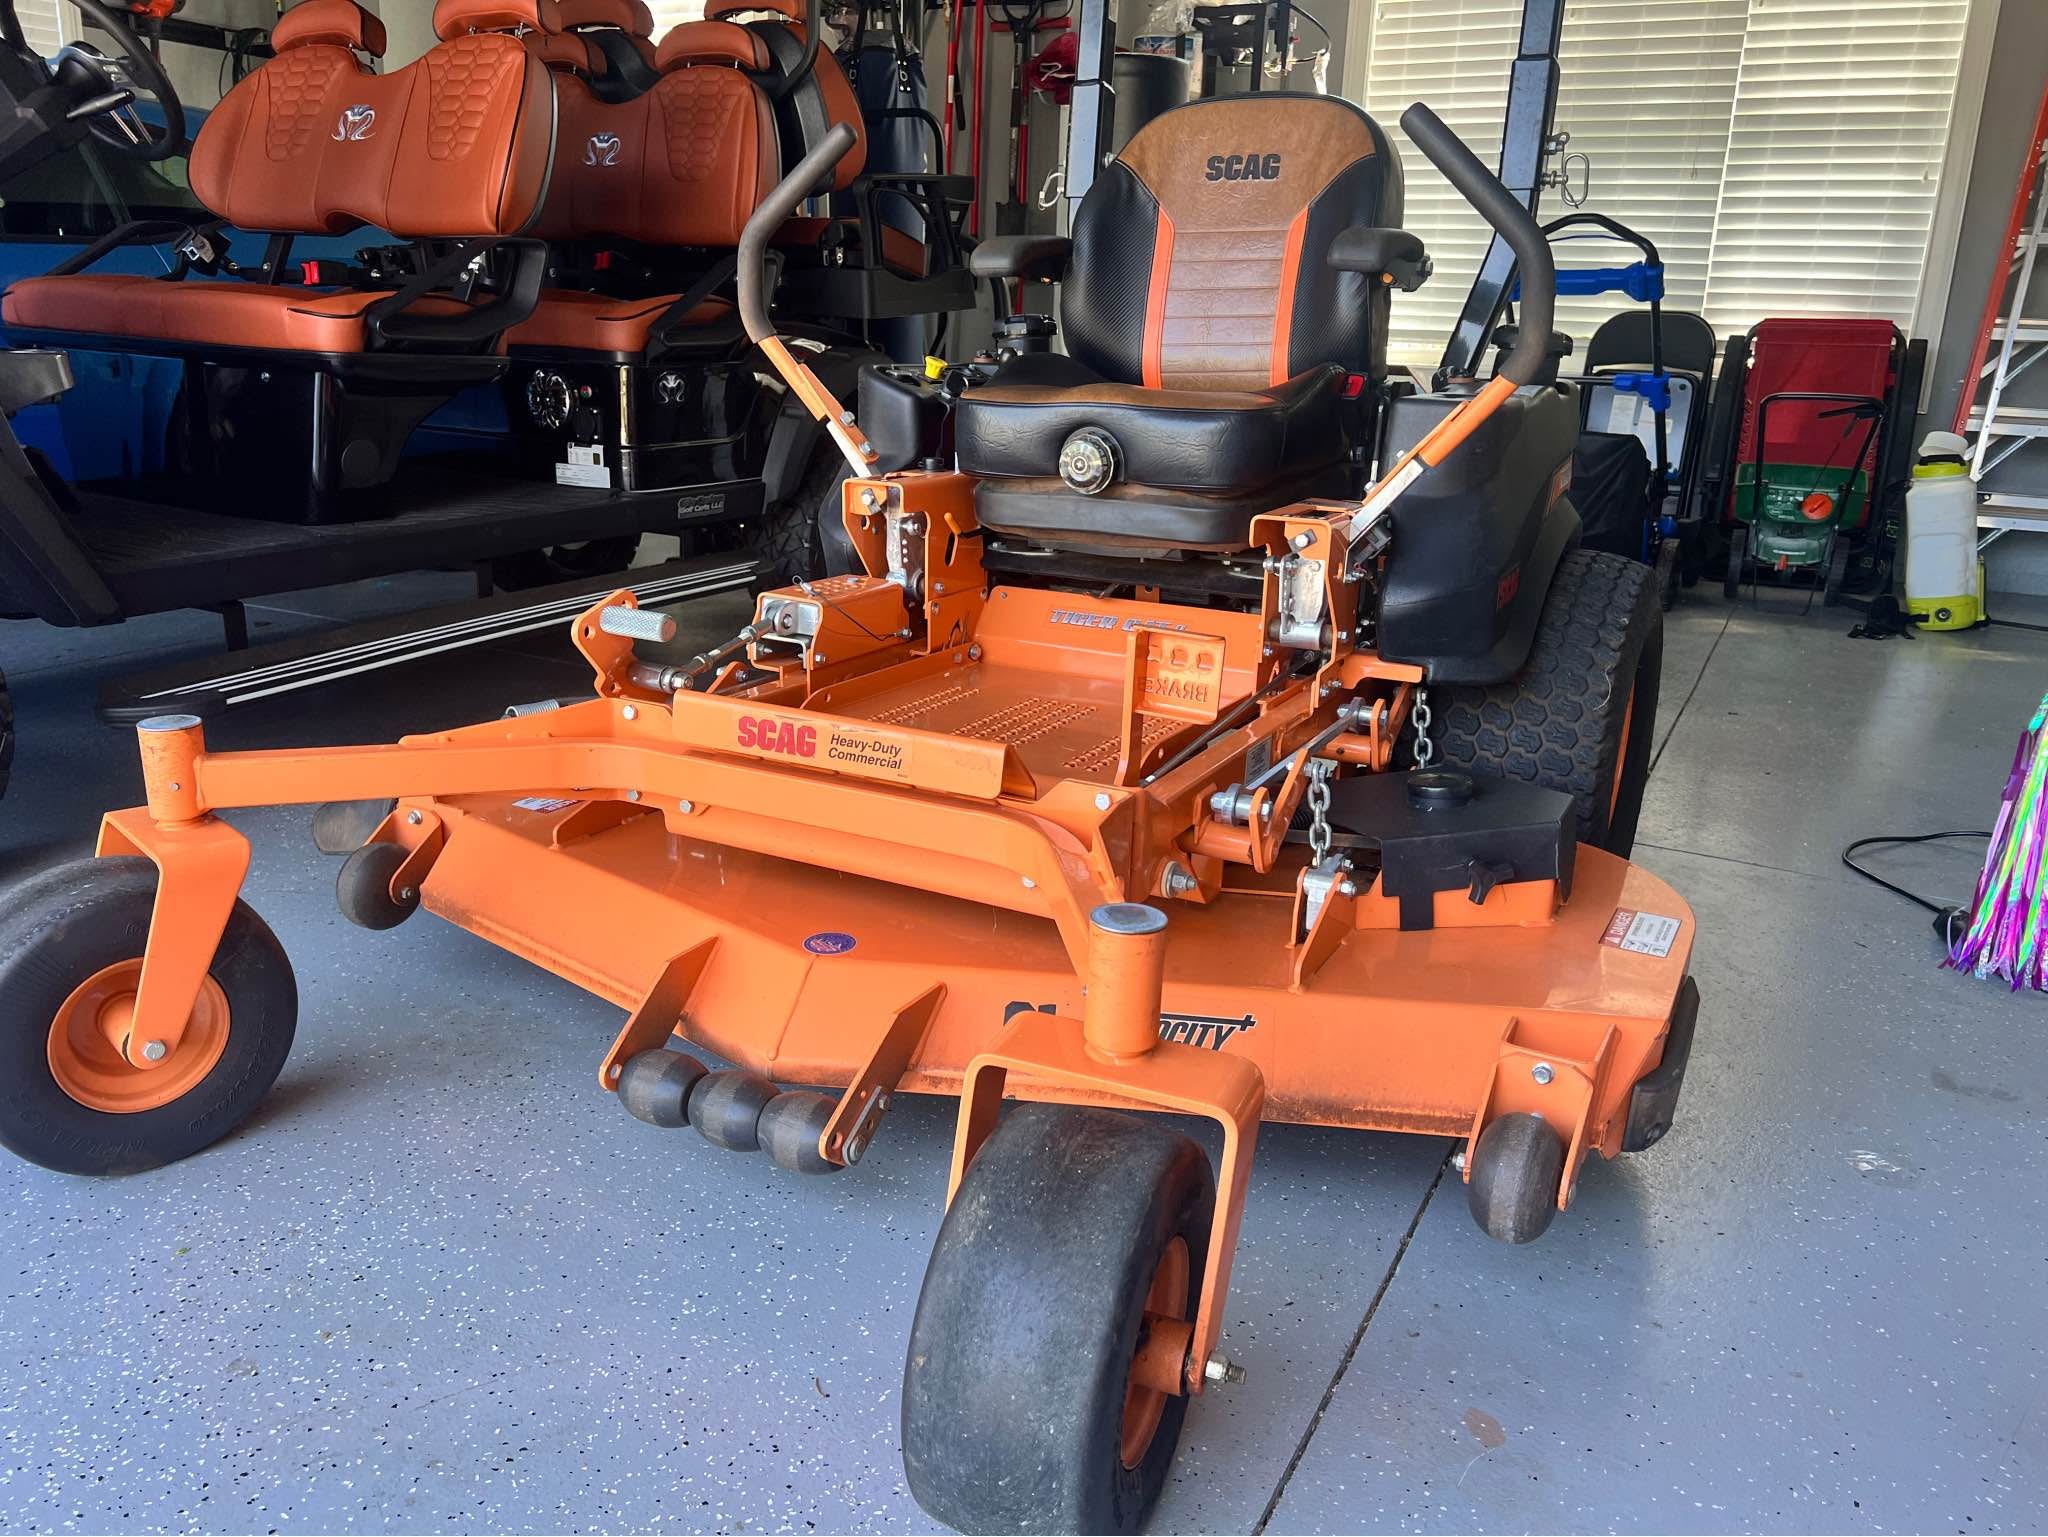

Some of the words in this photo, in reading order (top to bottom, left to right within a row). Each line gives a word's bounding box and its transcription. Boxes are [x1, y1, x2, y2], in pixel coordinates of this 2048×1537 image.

[1204, 153, 1281, 182] SCAG
[1050, 609, 1119, 629] TIGER
[737, 715, 817, 758] SCAG
[830, 733, 902, 757] Heavy-Duty
[828, 747, 902, 770] Commercial
